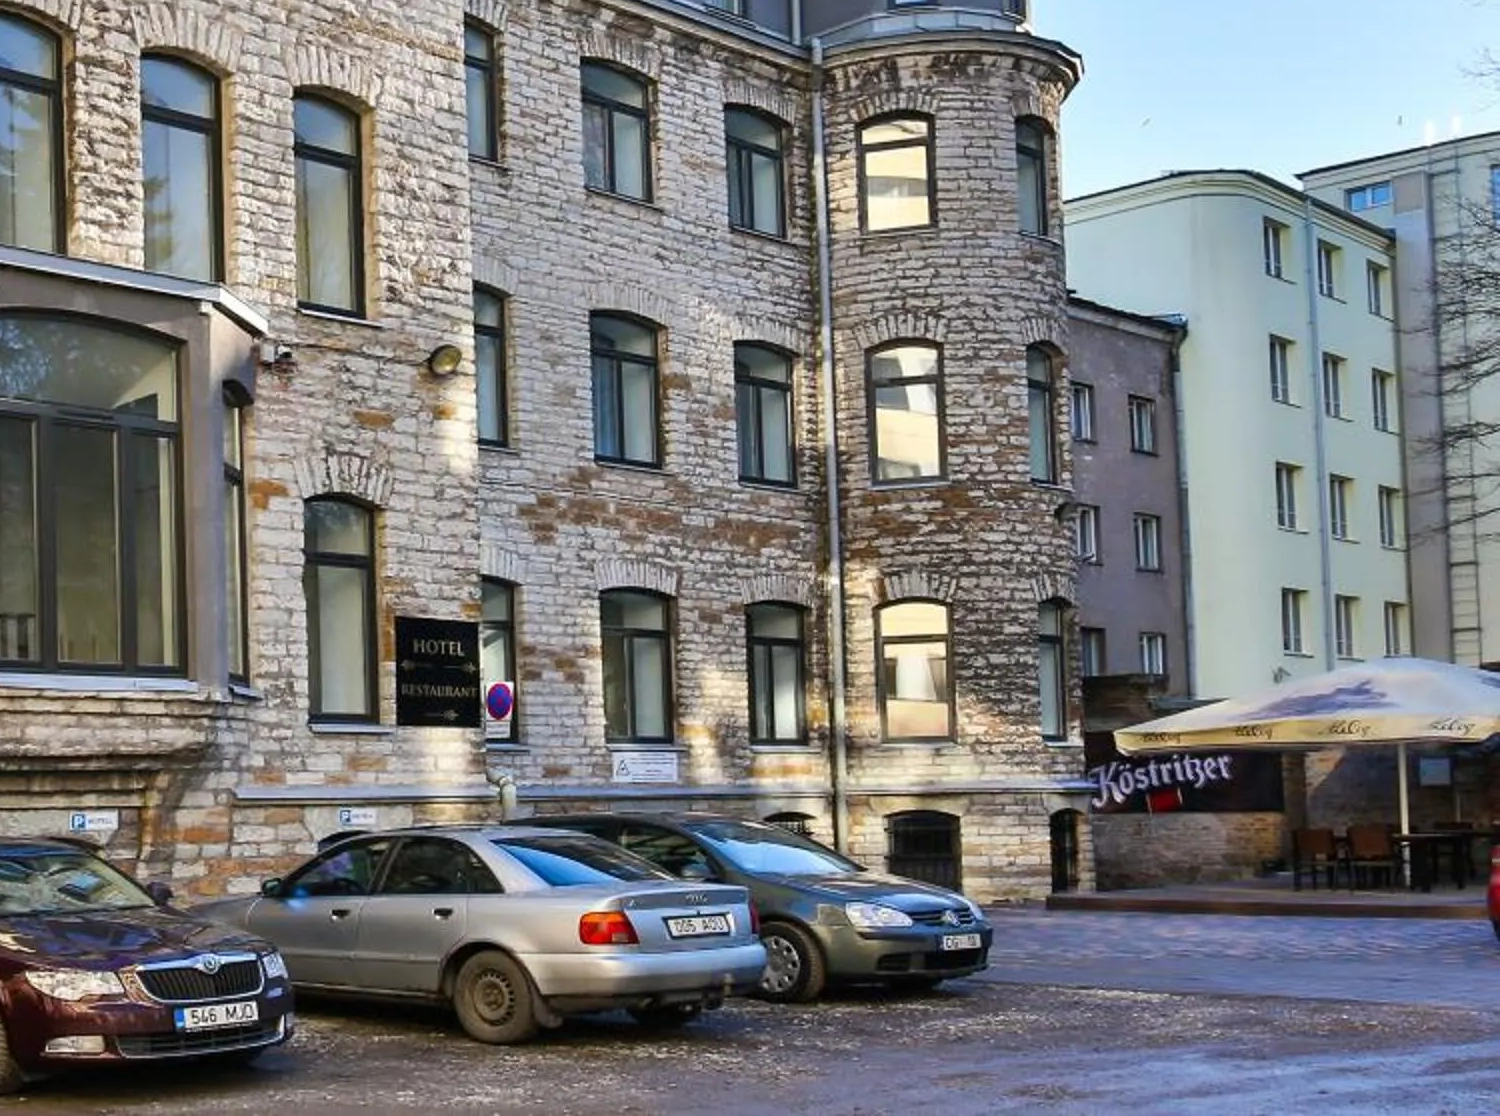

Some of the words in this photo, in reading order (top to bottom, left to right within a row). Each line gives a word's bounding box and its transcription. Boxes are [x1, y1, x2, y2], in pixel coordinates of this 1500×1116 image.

[412, 638, 465, 657] HOTEL
[401, 683, 478, 698] RESTAURANT
[1088, 753, 1233, 809] Köstritzer
